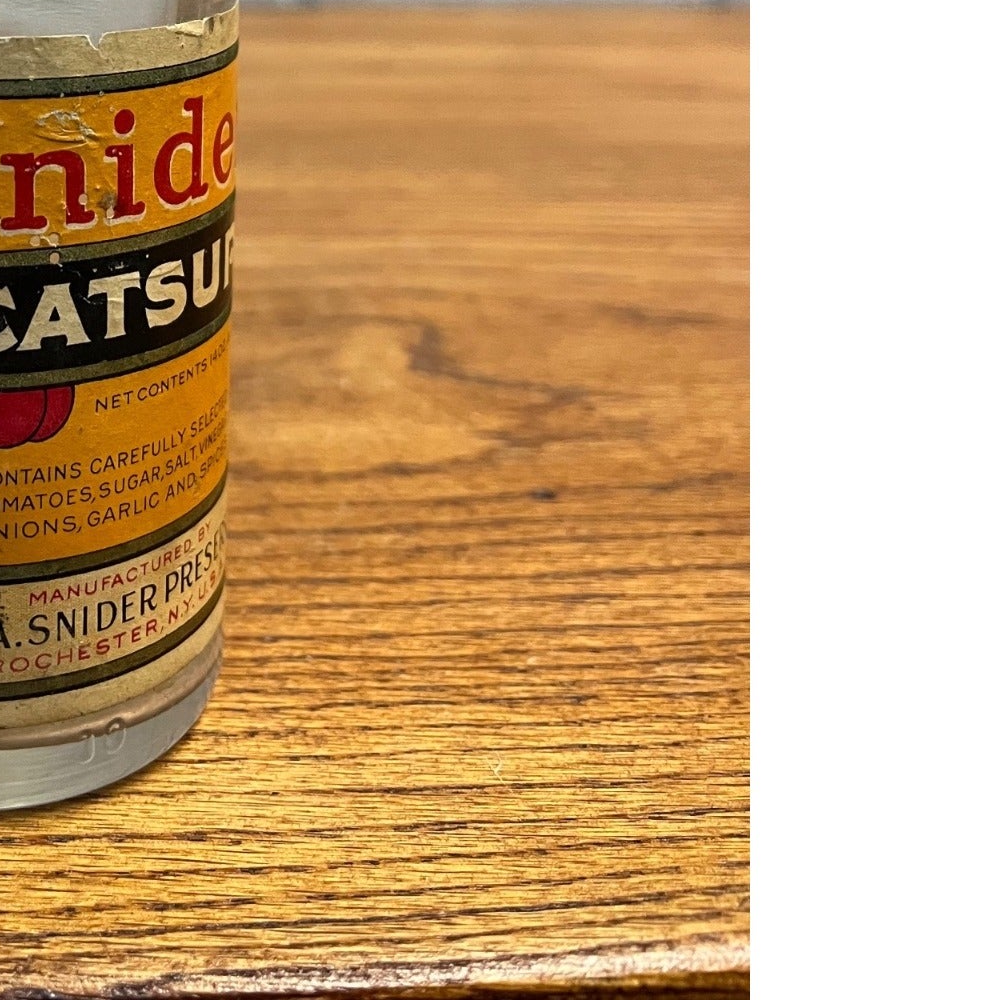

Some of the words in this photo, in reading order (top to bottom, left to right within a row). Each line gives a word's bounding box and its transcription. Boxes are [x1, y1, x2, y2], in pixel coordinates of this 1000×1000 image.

[95, 390, 134, 413] NET
[137, 358, 208, 401] CONTENTS
[90, 427, 187, 475] CAREFULLY
[87, 492, 161, 528] GARLIC
[165, 472, 197, 502] AND
[99, 466, 164, 499] SUGAR,
[29, 539, 192, 606] MANUFACTURED
[198, 521, 211, 542] BY
[28, 584, 158, 646] SNIDER
[168, 594, 195, 625] N.Y.
